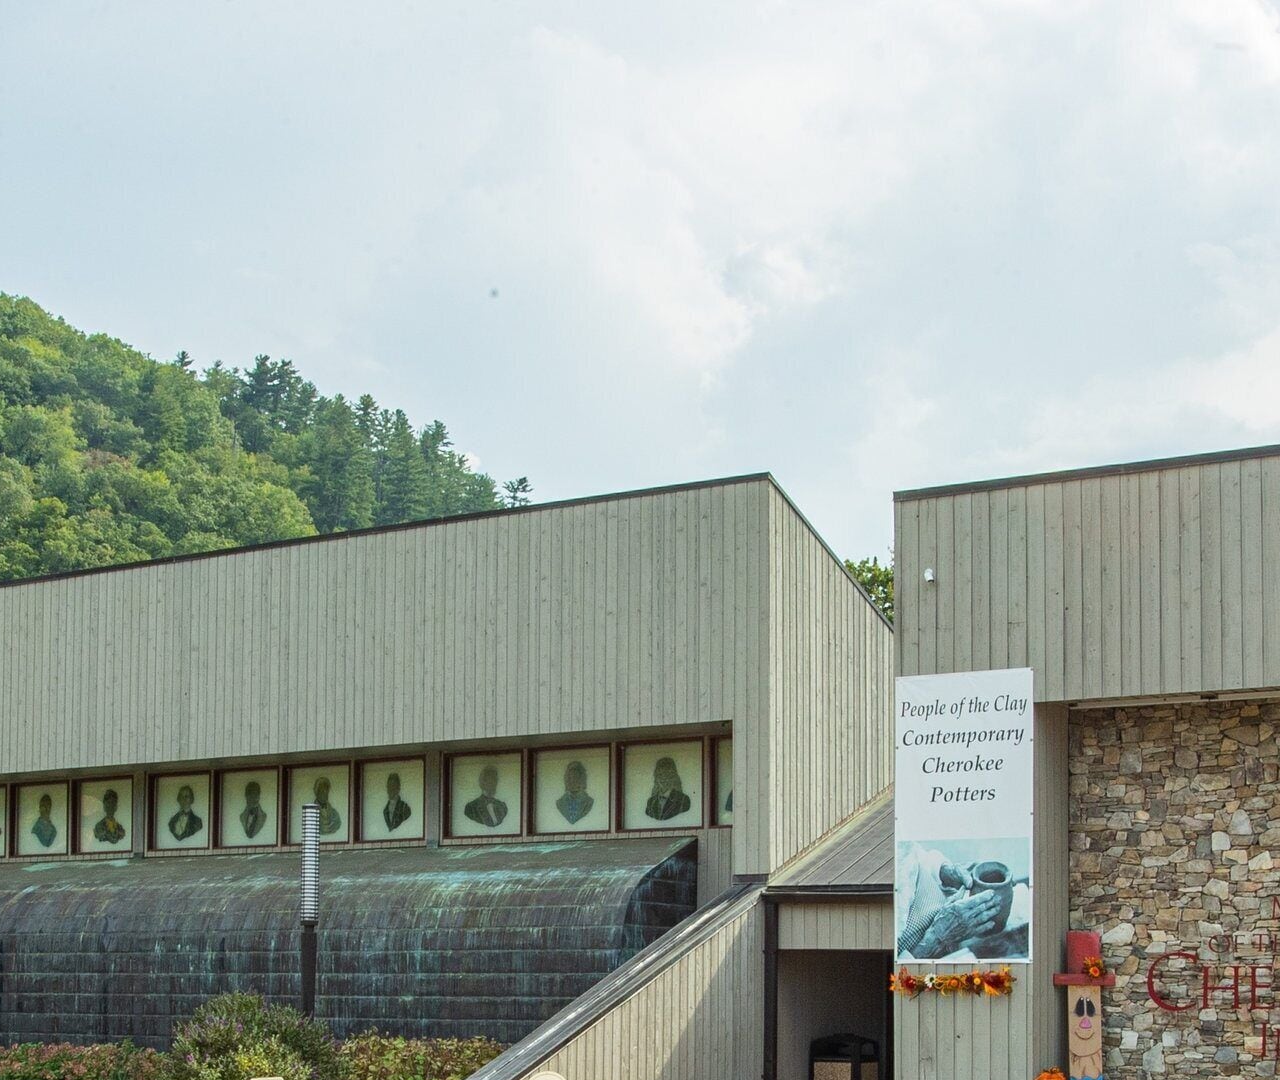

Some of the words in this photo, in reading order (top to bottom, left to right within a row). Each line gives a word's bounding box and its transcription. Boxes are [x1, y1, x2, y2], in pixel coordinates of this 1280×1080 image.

[901, 699, 946, 721] People
[950, 697, 966, 720] of
[969, 696, 990, 713] the
[994, 694, 1027, 716] Clay
[902, 728, 1025, 749] Contemporary
[922, 755, 1004, 774] Cherokee
[930, 786, 996, 803] Potters
[1209, 934, 1245, 953] OF
